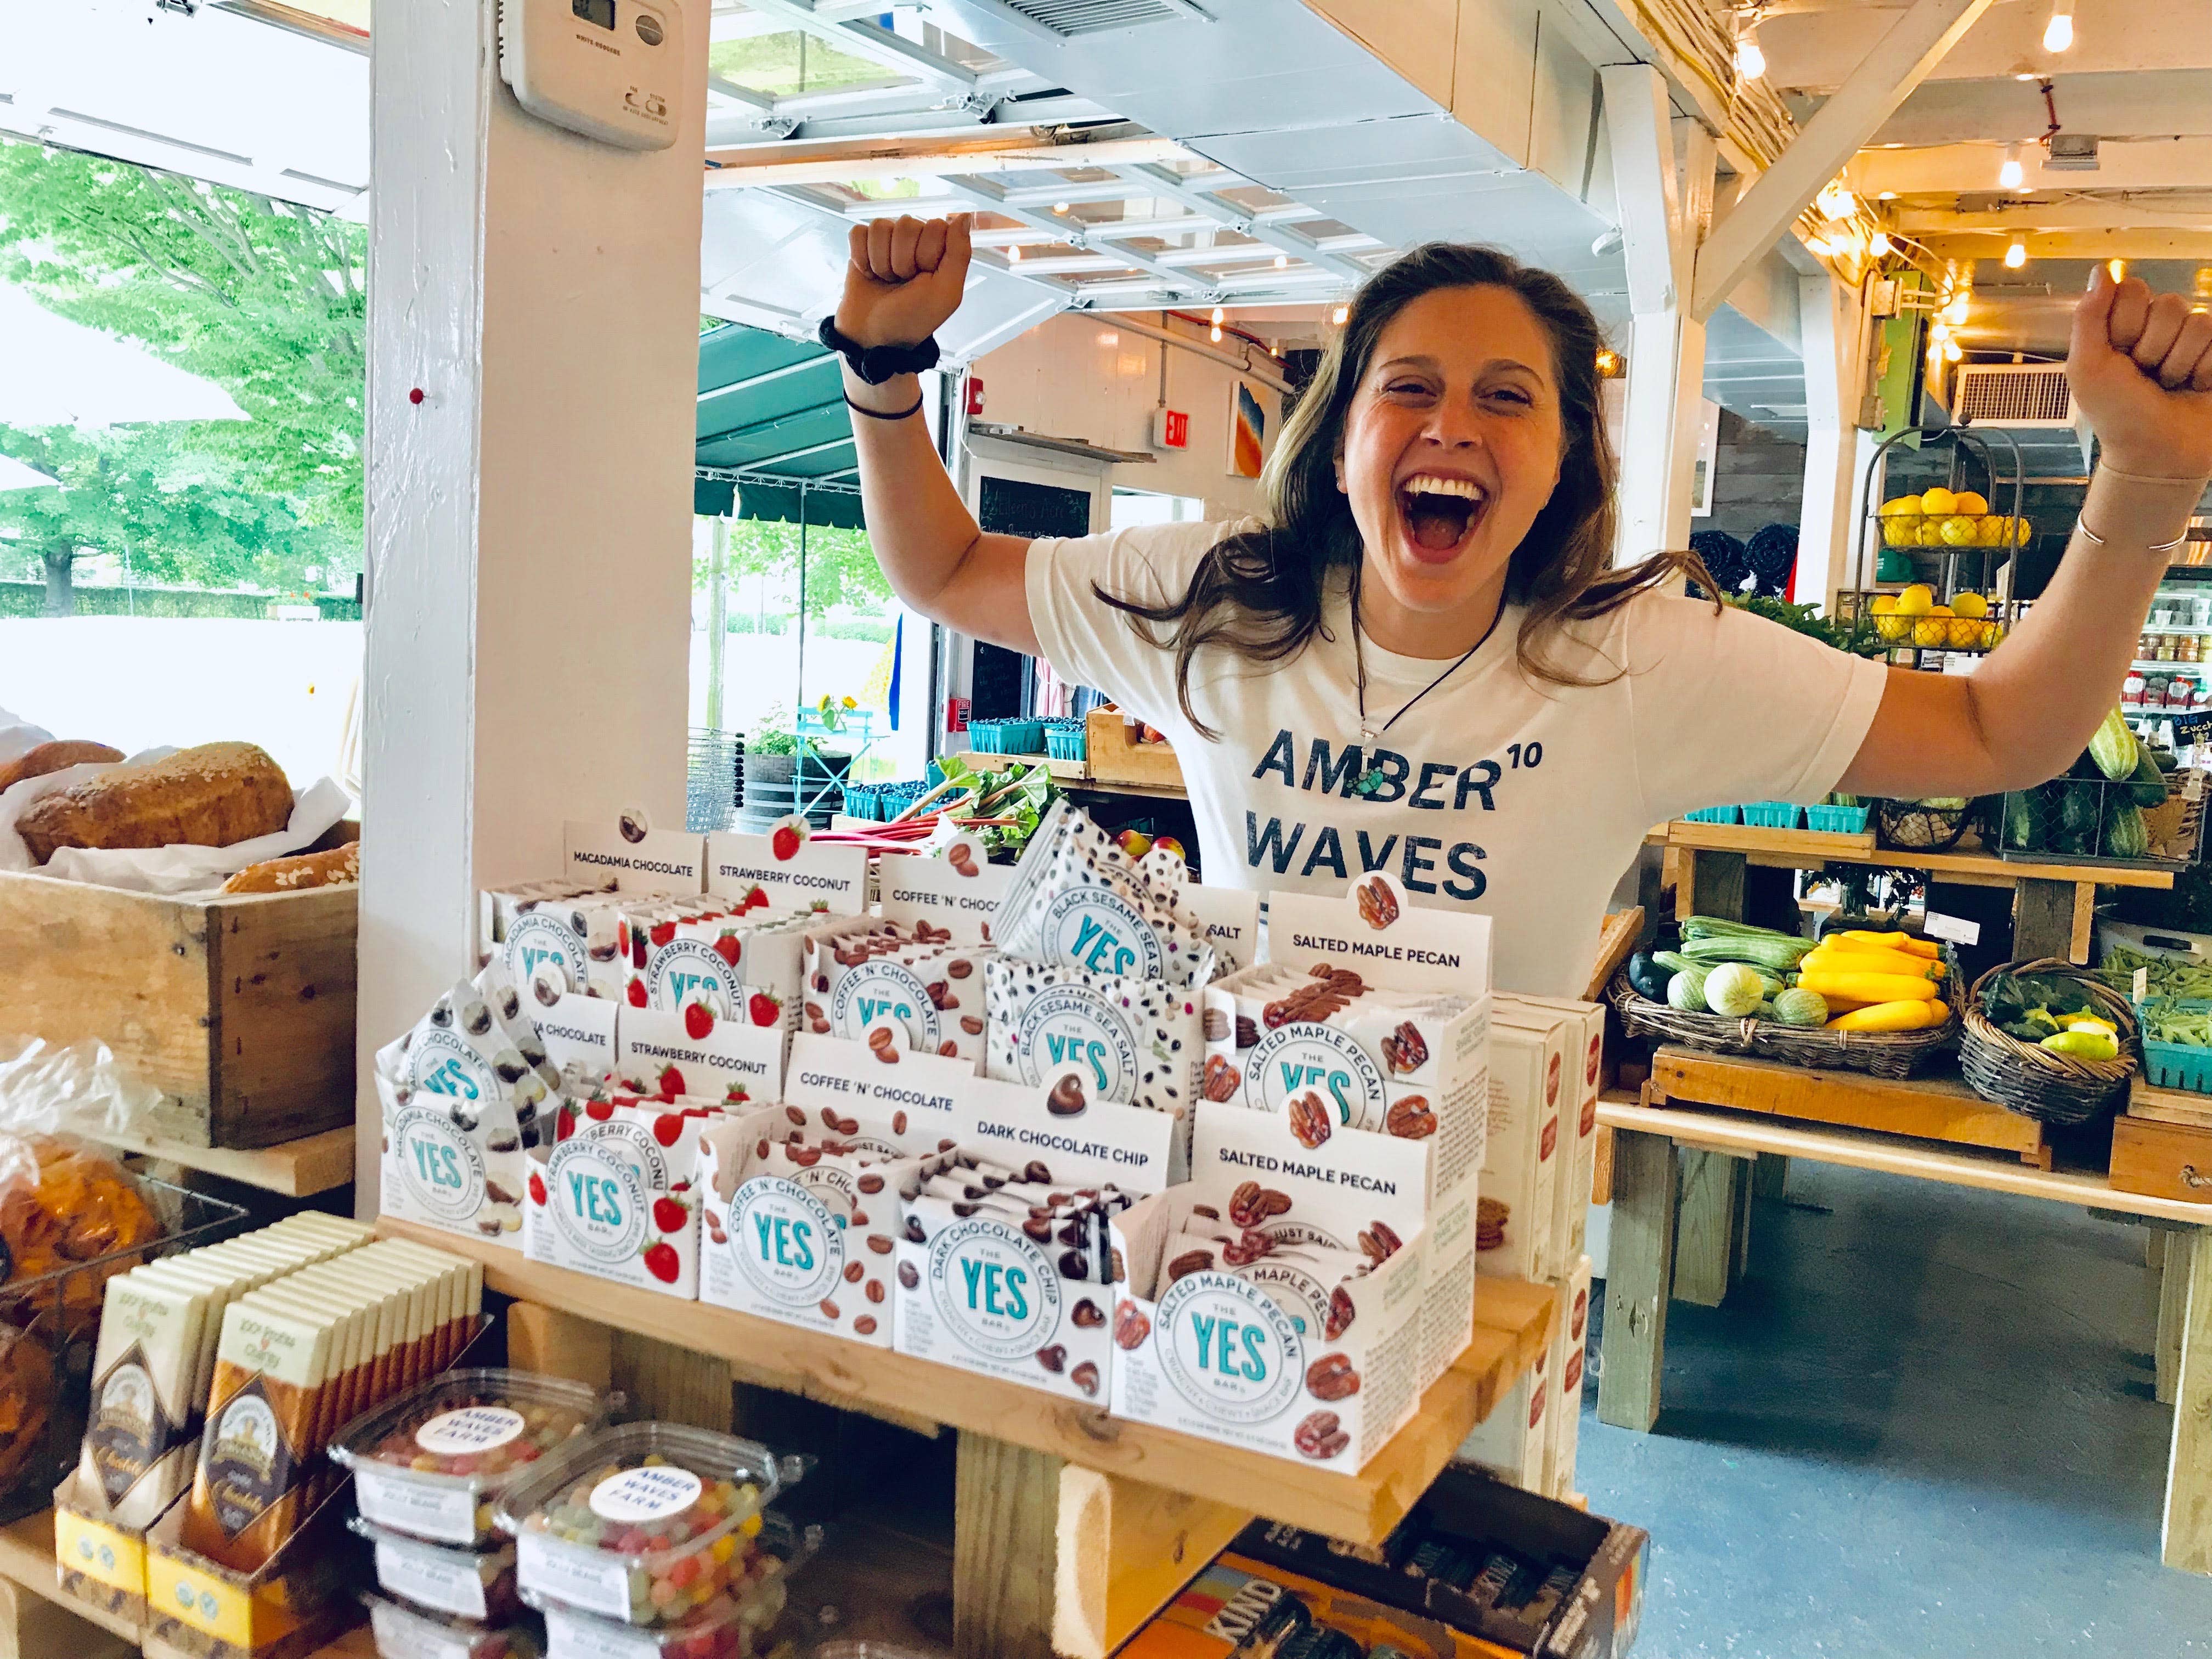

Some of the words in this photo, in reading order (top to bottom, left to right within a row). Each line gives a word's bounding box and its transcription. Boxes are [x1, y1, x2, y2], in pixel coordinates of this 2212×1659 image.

[1166, 410, 1188, 448] EXIT
[1252, 729, 1502, 811] AMBER
[1506, 742, 1542, 769] 10
[574, 851, 630, 869] MACADAMIA
[633, 859, 692, 877] CHOCOLATE
[720, 865, 791, 884] STRAWBERRY
[793, 874, 850, 891] COCONUT
[1246, 810, 1487, 900] WAVES
[893, 889, 938, 905] COFFEE
[941, 894, 957, 906] 'N'
[1052, 891, 1087, 919] BLACK
[1092, 891, 1144, 931] SESAME
[1140, 931, 1158, 961] SEA
[1209, 924, 1241, 939] SALT
[504, 918, 539, 970] MACADAMIA
[541, 919, 586, 984] CHOCOLATE
[1293, 934, 1348, 953] SALTED
[1352, 942, 1402, 960] MAPLE
[1407, 949, 1460, 967] PECAN
[650, 943, 697, 995] STRAWBERRY
[701, 947, 741, 1008] COCONUT
[873, 988, 890, 997] THE
[835, 970, 864, 1020] COFFEE
[881, 964, 938, 1036] CHOCOLATE
[421, 1032, 487, 1071] CHOCOLATE
[547, 1022, 606, 1046] CHOCOLATE
[1022, 1011, 1042, 1056] BLACK
[1040, 999, 1093, 1015] SESAME
[1094, 1011, 1118, 1039] SEA
[1117, 1040, 1133, 1076] SALT
[1063, 1024, 1082, 1033] THE
[631, 1042, 706, 1064] STRAWBERRY
[709, 1054, 767, 1075] COCONUT
[1249, 1029, 1287, 1082] SALTED
[1289, 1026, 1345, 1048] MAPLE
[1346, 1045, 1380, 1101] PECAN
[1301, 1052, 1324, 1063] THE
[800, 1071, 850, 1092] COFFEE
[854, 1081, 871, 1095] 'N'
[873, 1085, 953, 1111] CHOCOLATE
[410, 1137, 462, 1189] YES
[425, 1112, 483, 1178] CHOCOLATE
[978, 1121, 1015, 1140] DARK
[1019, 1130, 1108, 1159] CHOCOLATE
[1113, 1150, 1149, 1167] CHIP
[597, 1149, 645, 1213] COCONUT
[1220, 1148, 1278, 1171] SALTED
[1283, 1161, 1335, 1183] MAPLE
[1340, 1172, 1396, 1195] PECAN
[566, 1170, 622, 1226] YES
[732, 1184, 756, 1233] COFFEE
[776, 1180, 840, 1256] CHOCOLATE
[769, 1204, 787, 1214] THE
[753, 1211, 814, 1270] YES
[980, 1248, 1001, 1259] THE
[933, 1239, 952, 1279] DARK
[950, 1222, 1040, 1262] CHOCOLATE
[1038, 1265, 1057, 1306] CHIP
[1254, 1268, 1310, 1293] MAPLE
[961, 1256, 1028, 1320] YES
[1213, 1303, 1236, 1316] THE
[1159, 1279, 1196, 1330] SALTED
[1200, 1274, 1258, 1302] MAPLE
[1260, 1300, 1297, 1359] PECAN
[1191, 1311, 1267, 1382] YES
[609, 1489, 662, 1509] FARM
[624, 1480, 680, 1501] WAVES
[637, 1470, 696, 1491] AMBER
[1204, 1578, 1282, 1645] KIND
